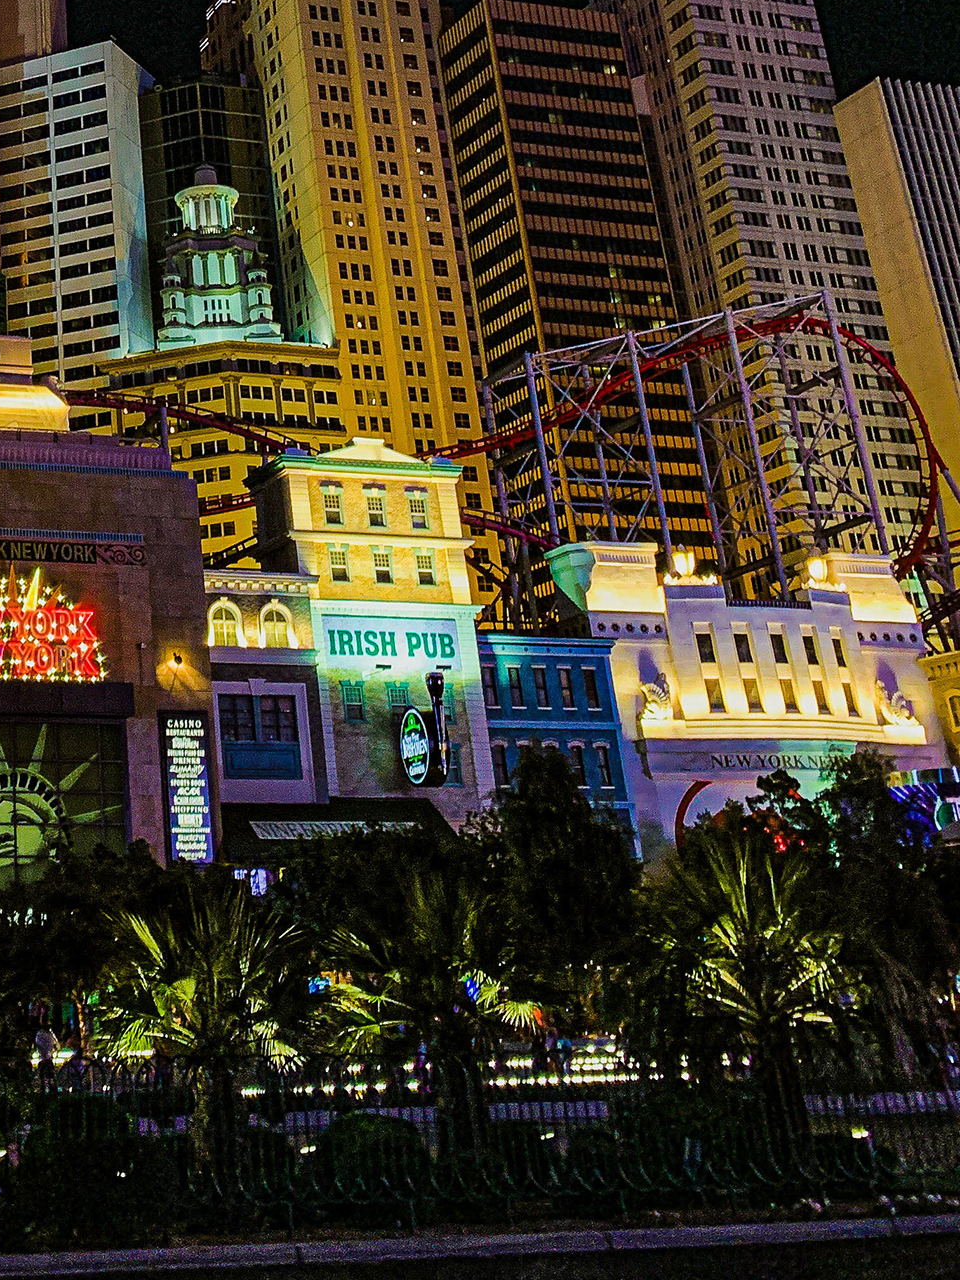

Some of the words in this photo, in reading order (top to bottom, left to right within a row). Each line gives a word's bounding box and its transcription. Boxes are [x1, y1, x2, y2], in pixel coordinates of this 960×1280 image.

[10, 542, 47, 561] NEW
[48, 544, 96, 562] YORK
[6, 608, 97, 641] YORK
[328, 629, 397, 657] IRISH
[405, 632, 456, 659] PUB
[8, 643, 100, 675] YORK
[167, 719, 202, 728] CASINO
[711, 754, 753, 769] NEW
[755, 754, 807, 769] YORK
